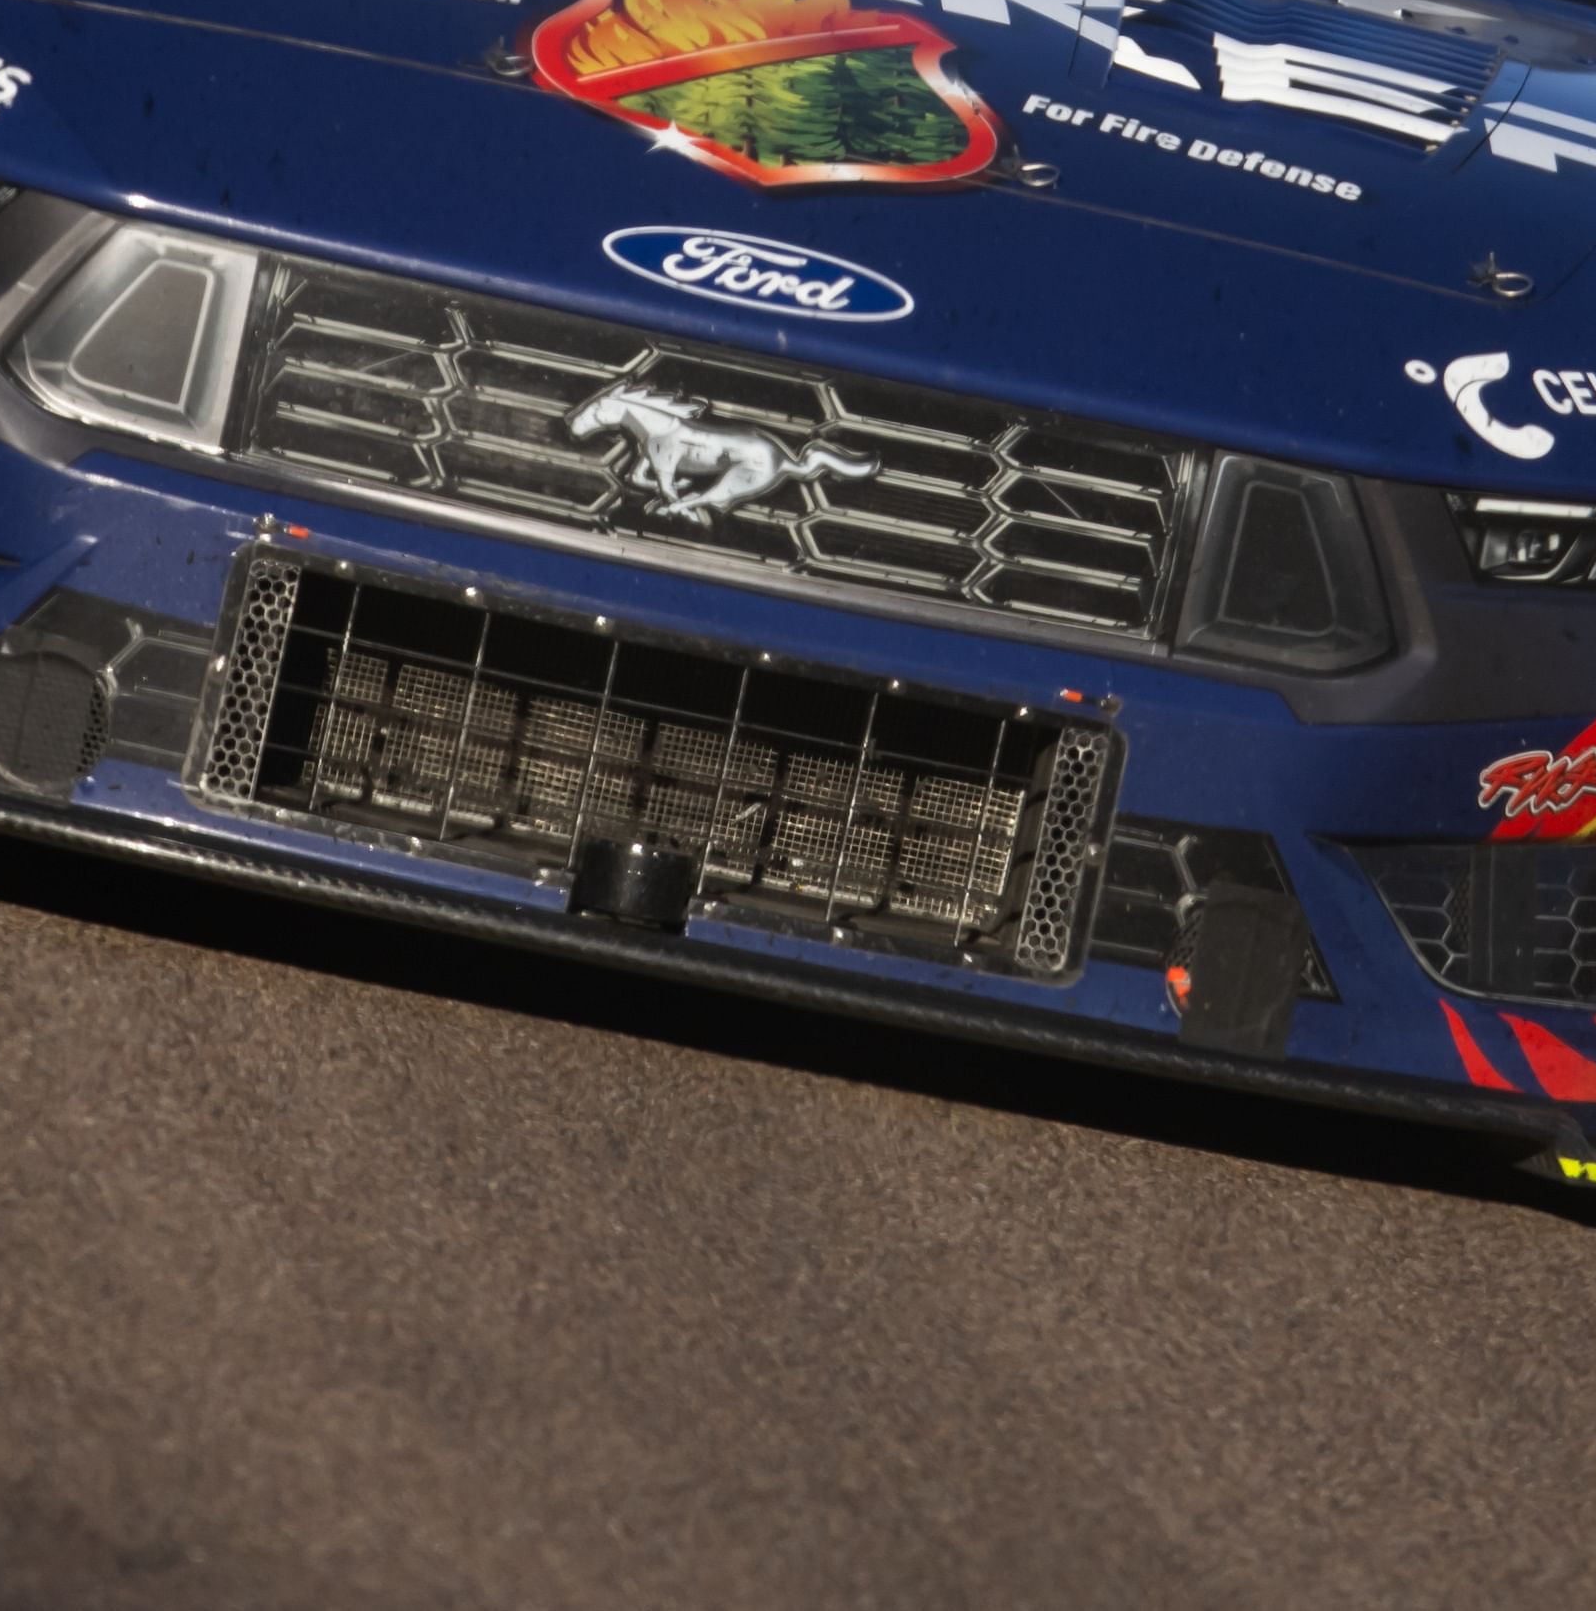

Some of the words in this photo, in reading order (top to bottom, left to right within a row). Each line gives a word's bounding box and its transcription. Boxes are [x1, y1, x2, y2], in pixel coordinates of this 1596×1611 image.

[1022, 94, 1094, 127] For
[1099, 112, 1182, 152] Fire
[1187, 139, 1363, 202] Defense
[662, 236, 856, 311] Ford
